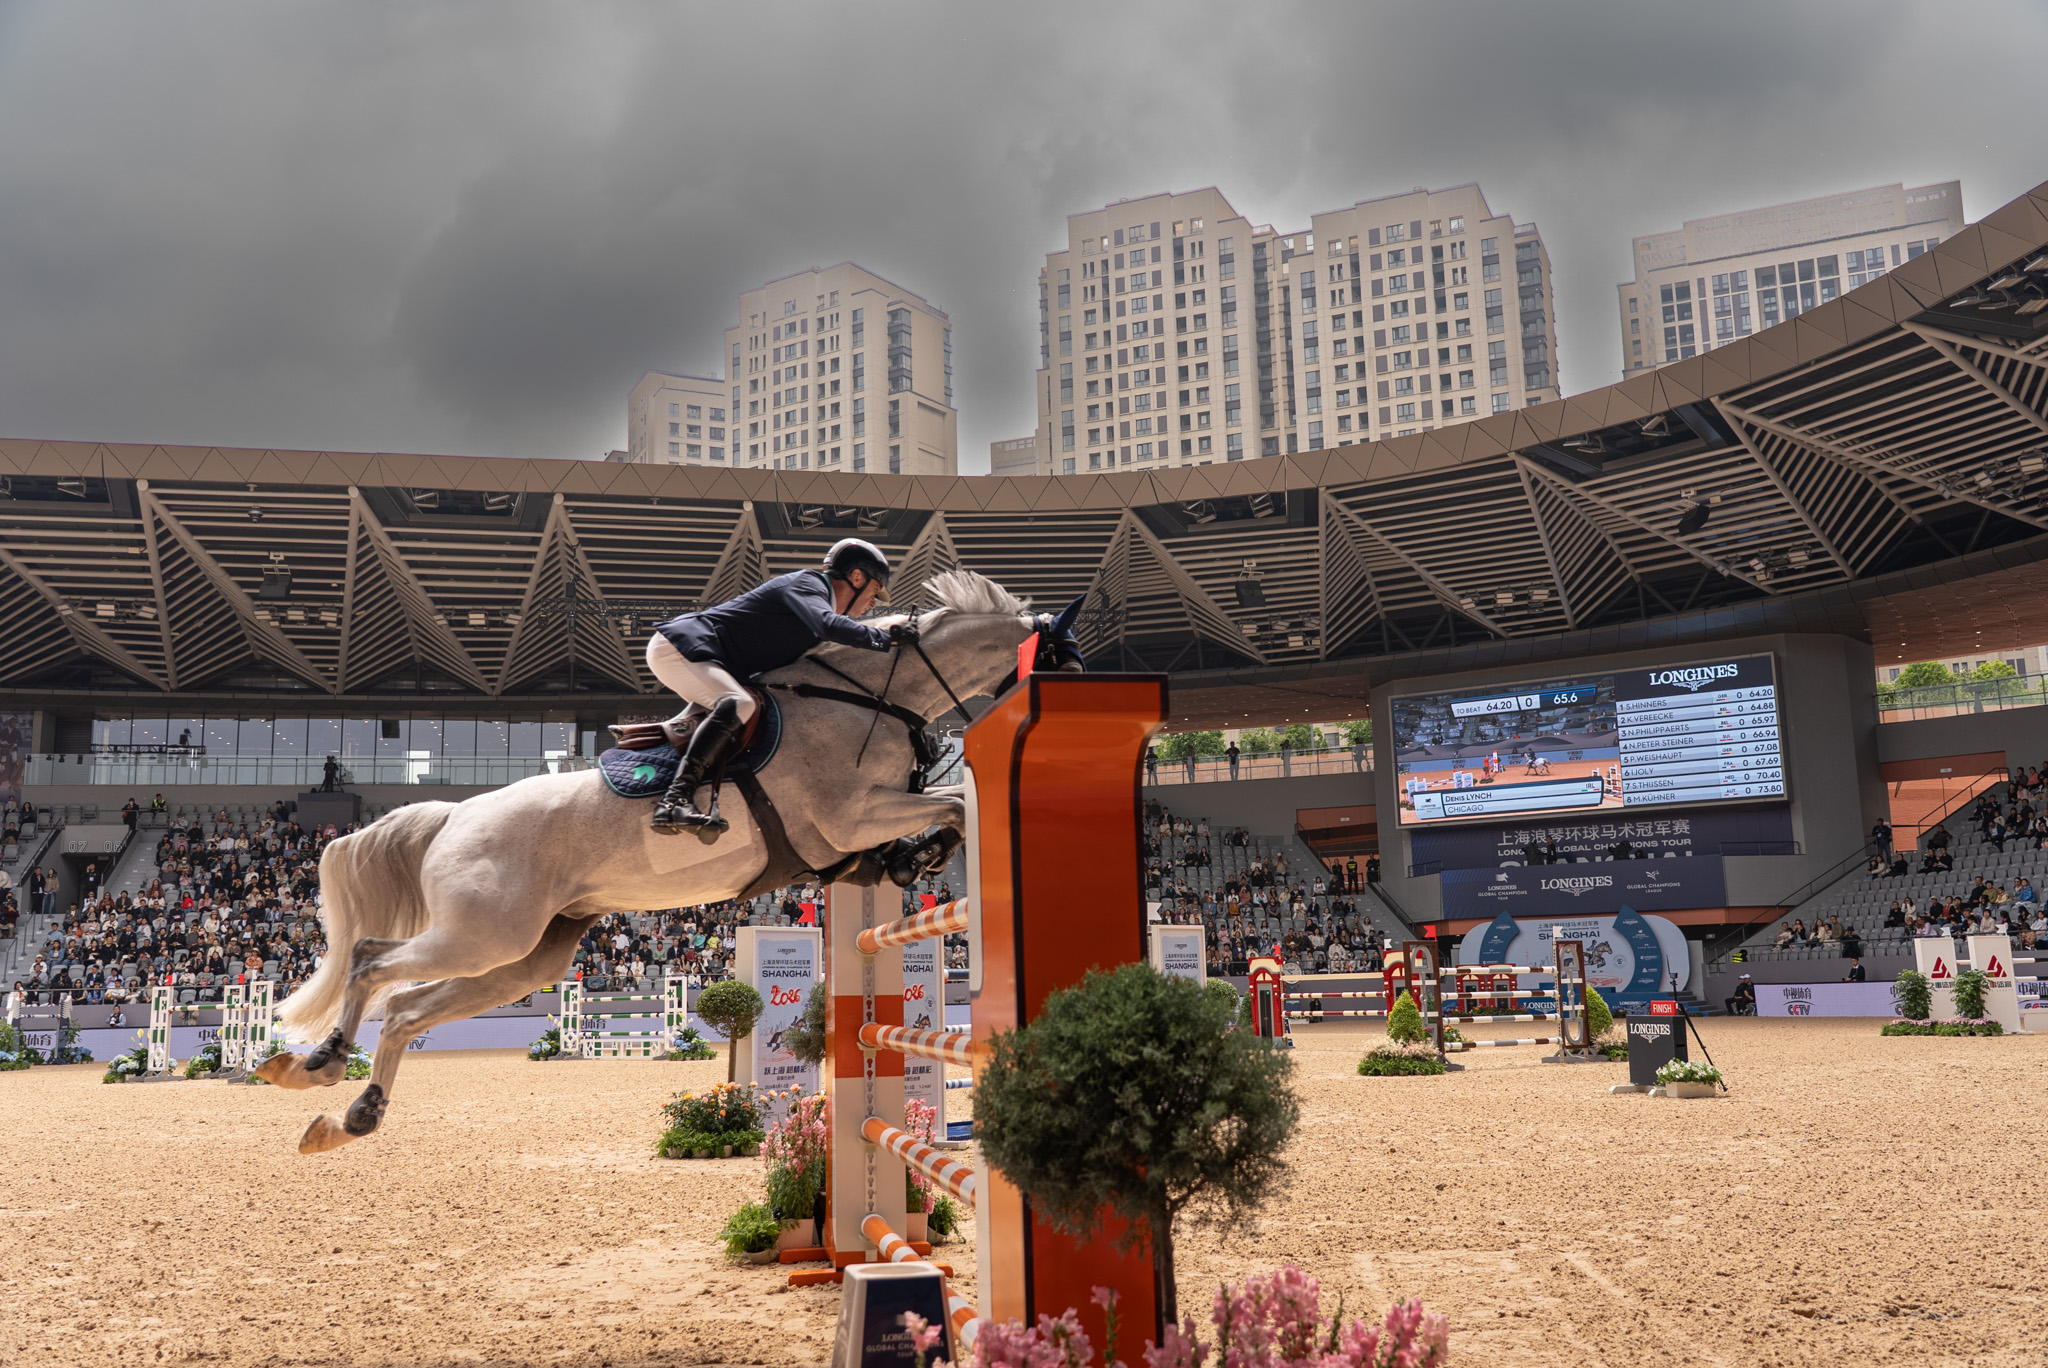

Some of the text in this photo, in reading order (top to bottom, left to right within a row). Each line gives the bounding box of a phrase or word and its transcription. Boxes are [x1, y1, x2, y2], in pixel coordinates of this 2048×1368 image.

[1649, 664, 1738, 686] LONGINES
[1466, 706, 1481, 714] BEAT
[1486, 701, 1512, 712] 64.20
[1525, 697, 1532, 708] 0
[1553, 692, 1578, 704] 65.6
[1626, 700, 1667, 710] S.HINNERS
[1750, 688, 1772, 697] 64.20
[1627, 712, 1674, 721] K.VEREECKE
[1750, 702, 1774, 711] 64.88
[1628, 724, 1690, 736] N.PHILIPPAERTS
[1752, 716, 1774, 724] 65.97
[1629, 740, 1660, 750] N.PETER
[1662, 737, 1694, 746] STEINER
[1753, 730, 1776, 738] 66.94
[1630, 752, 1682, 762] P.WEISHAUPT
[1754, 743, 1778, 752] 67.08
[1755, 757, 1778, 765] 67.69
[1757, 771, 1780, 779] 70.40
[1758, 785, 1781, 793] 73.80
[1466, 792, 1492, 801] LYNCH
[1448, 804, 1484, 813] CHICAGO
[1497, 819, 1690, 846] 上海浪琴环球马术冠军赛
[68, 841, 87, 852] 07
[1498, 846, 1548, 856] LONGS
[1594, 840, 1658, 850] CHAIONS
[1541, 876, 1613, 890] LONGINES
[1538, 931, 1600, 940] SHNGHAI
[1165, 962, 1198, 970] SHANGHAI
[903, 984, 925, 1001] 026
[1783, 988, 1812, 999] 中视体育
[2018, 982, 2048, 996] 中视体
[770, 985, 802, 1006] 2026
[1653, 1004, 1672, 1014] FINISH
[1788, 1004, 1810, 1015] CCTV
[1630, 1024, 1670, 1035] LONGINES
[882, 1332, 912, 1342] LONGI
[866, 1344, 895, 1352] GLOBAL
